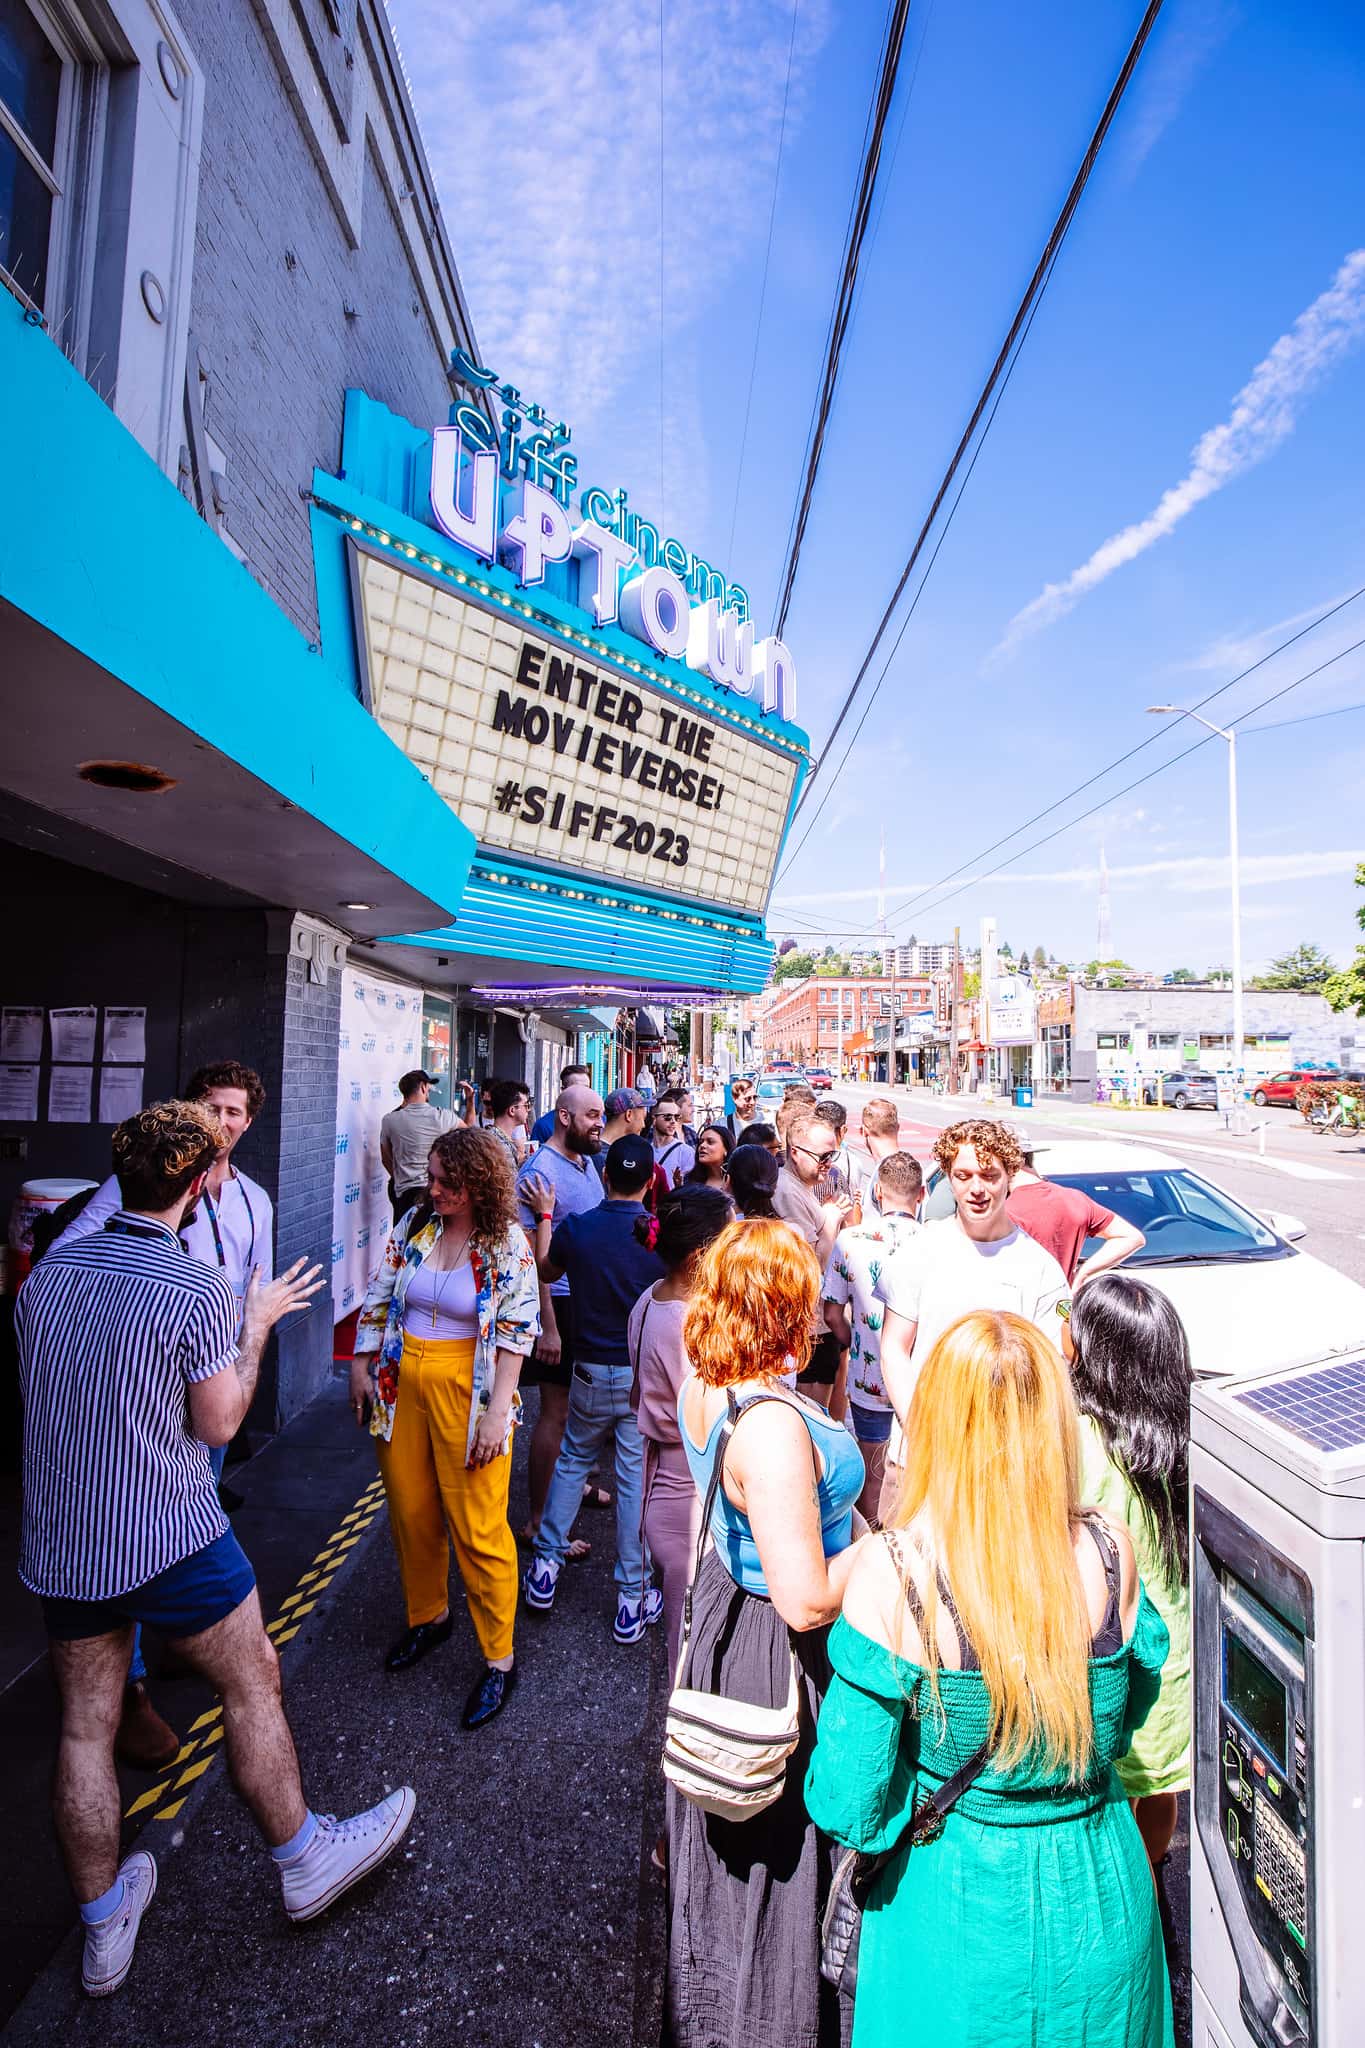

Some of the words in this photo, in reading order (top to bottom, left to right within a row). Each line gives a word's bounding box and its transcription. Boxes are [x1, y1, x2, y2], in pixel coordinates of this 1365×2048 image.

[449, 400, 577, 510] siff
[581, 487, 750, 624] cinema
[492, 690, 725, 810] MOVIEVERSE!
[516, 642, 643, 733] ENTER
[659, 707, 715, 764] THE
[494, 780, 690, 867] #SIFF2023
